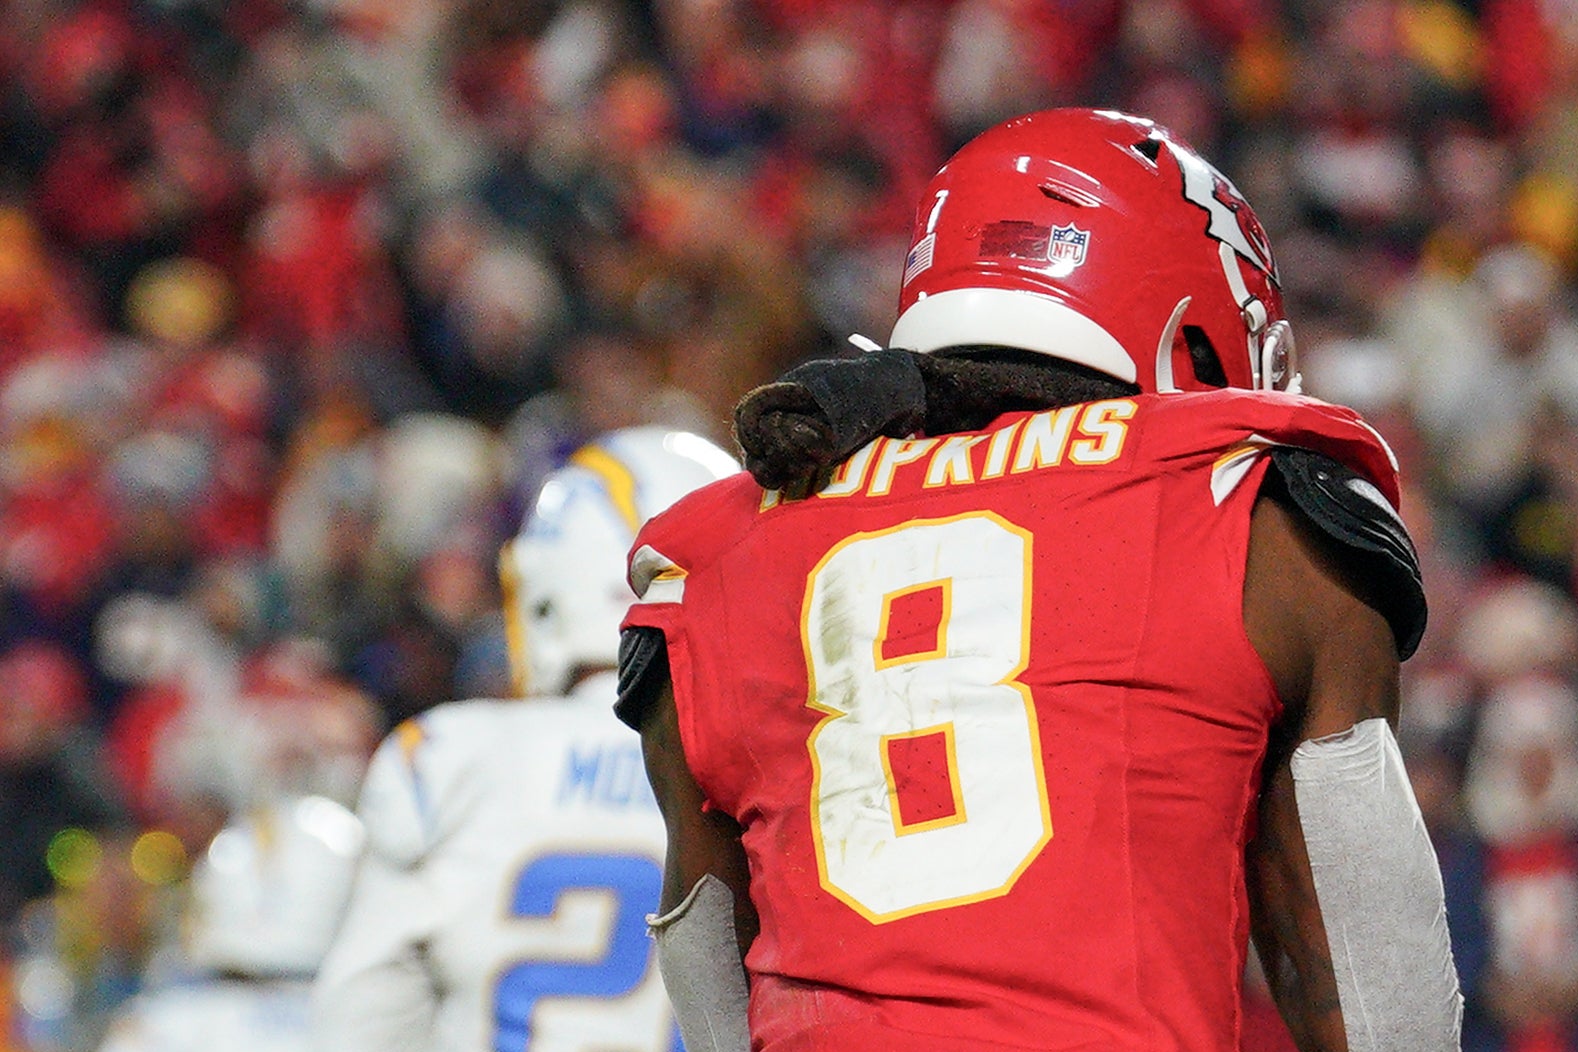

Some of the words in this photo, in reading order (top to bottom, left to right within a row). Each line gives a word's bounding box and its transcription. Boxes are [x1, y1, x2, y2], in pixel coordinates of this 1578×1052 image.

[1052, 241, 1081, 263] NFL
[759, 399, 1139, 513] OPKINS
[800, 510, 1053, 926] 8
